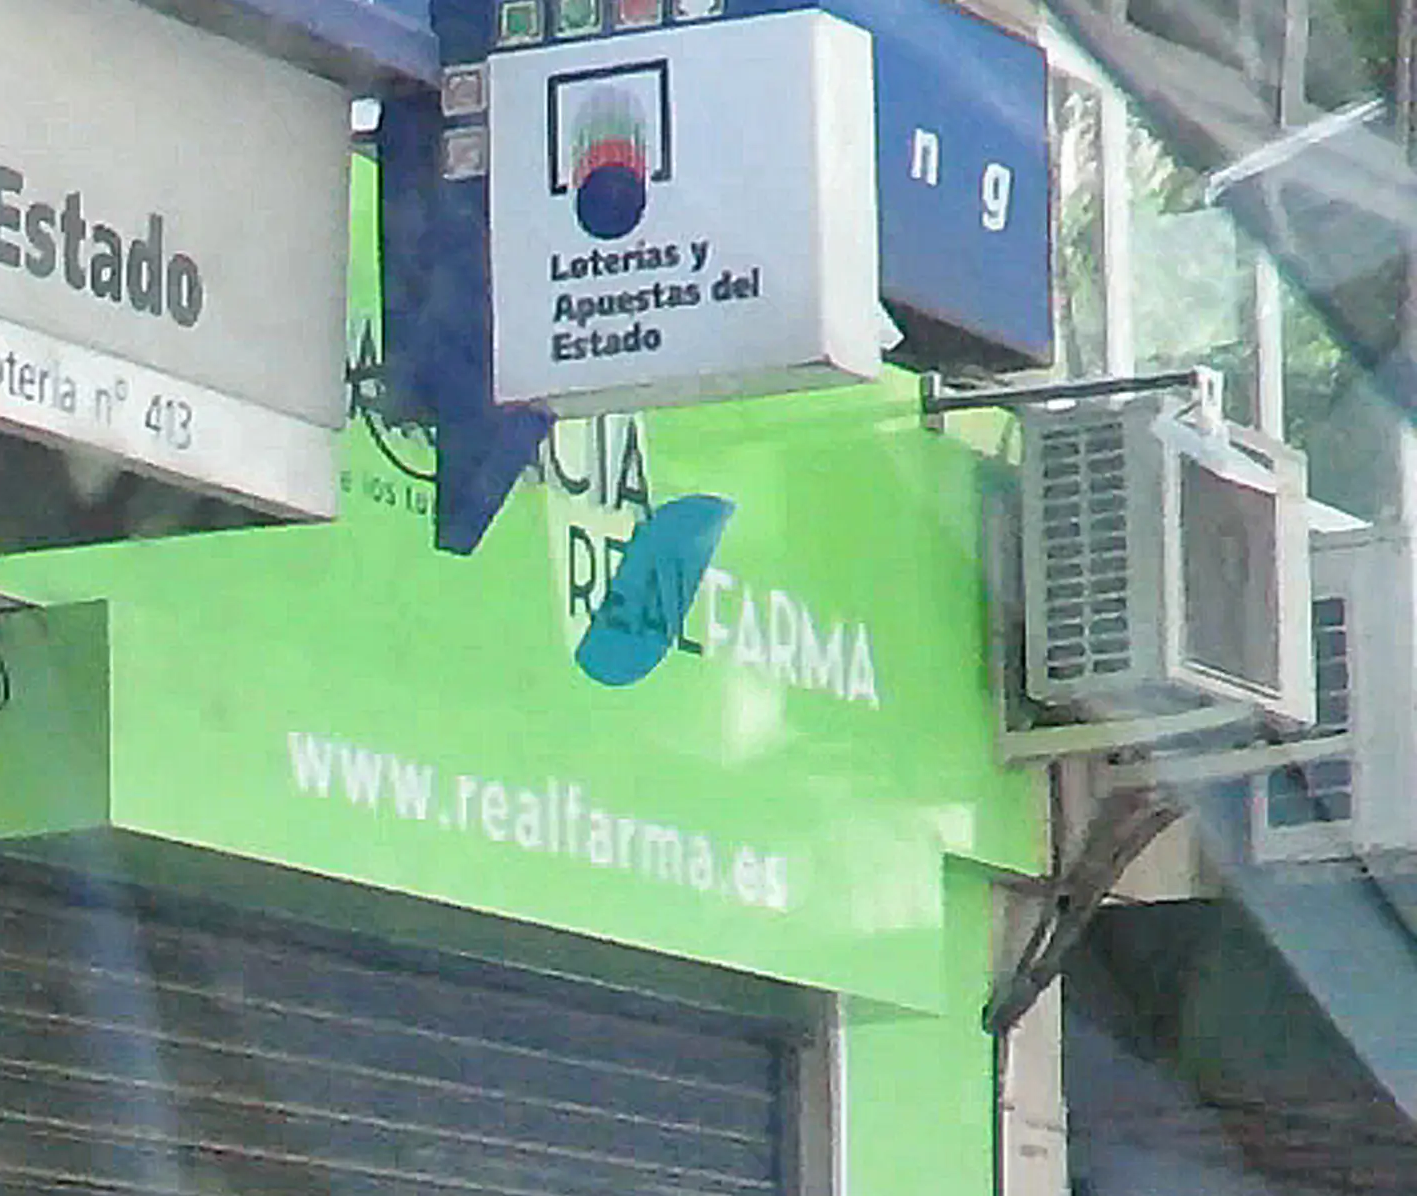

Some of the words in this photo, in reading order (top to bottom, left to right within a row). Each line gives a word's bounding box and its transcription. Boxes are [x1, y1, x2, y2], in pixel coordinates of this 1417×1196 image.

[690, 240, 709, 272] y
[552, 282, 701, 328] Apuestas
[712, 268, 760, 301] del
[551, 322, 662, 361] Estado
[144, 394, 194, 450] 413
[286, 731, 788, 914] www.realfarma.es
